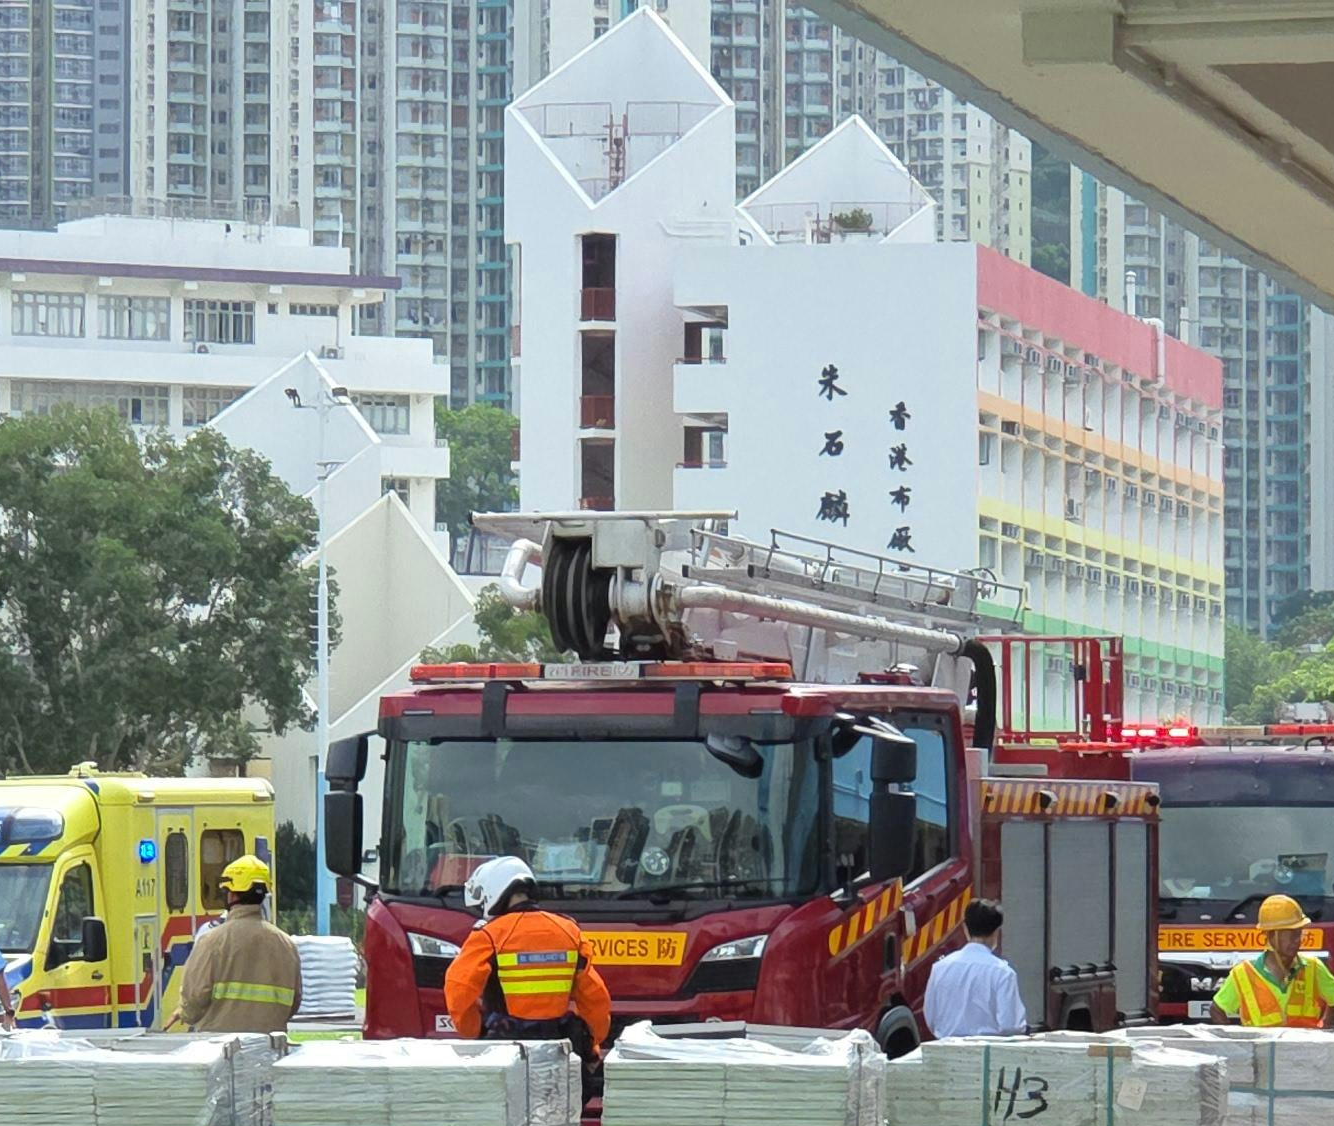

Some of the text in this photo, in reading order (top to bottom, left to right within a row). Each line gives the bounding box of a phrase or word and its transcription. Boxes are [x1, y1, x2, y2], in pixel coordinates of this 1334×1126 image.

[886, 401, 916, 572] 香港布廠
[135, 878, 156, 898] A117
[588, 939, 649, 957] RVICES
[1203, 932, 1268, 947] SERVIC
